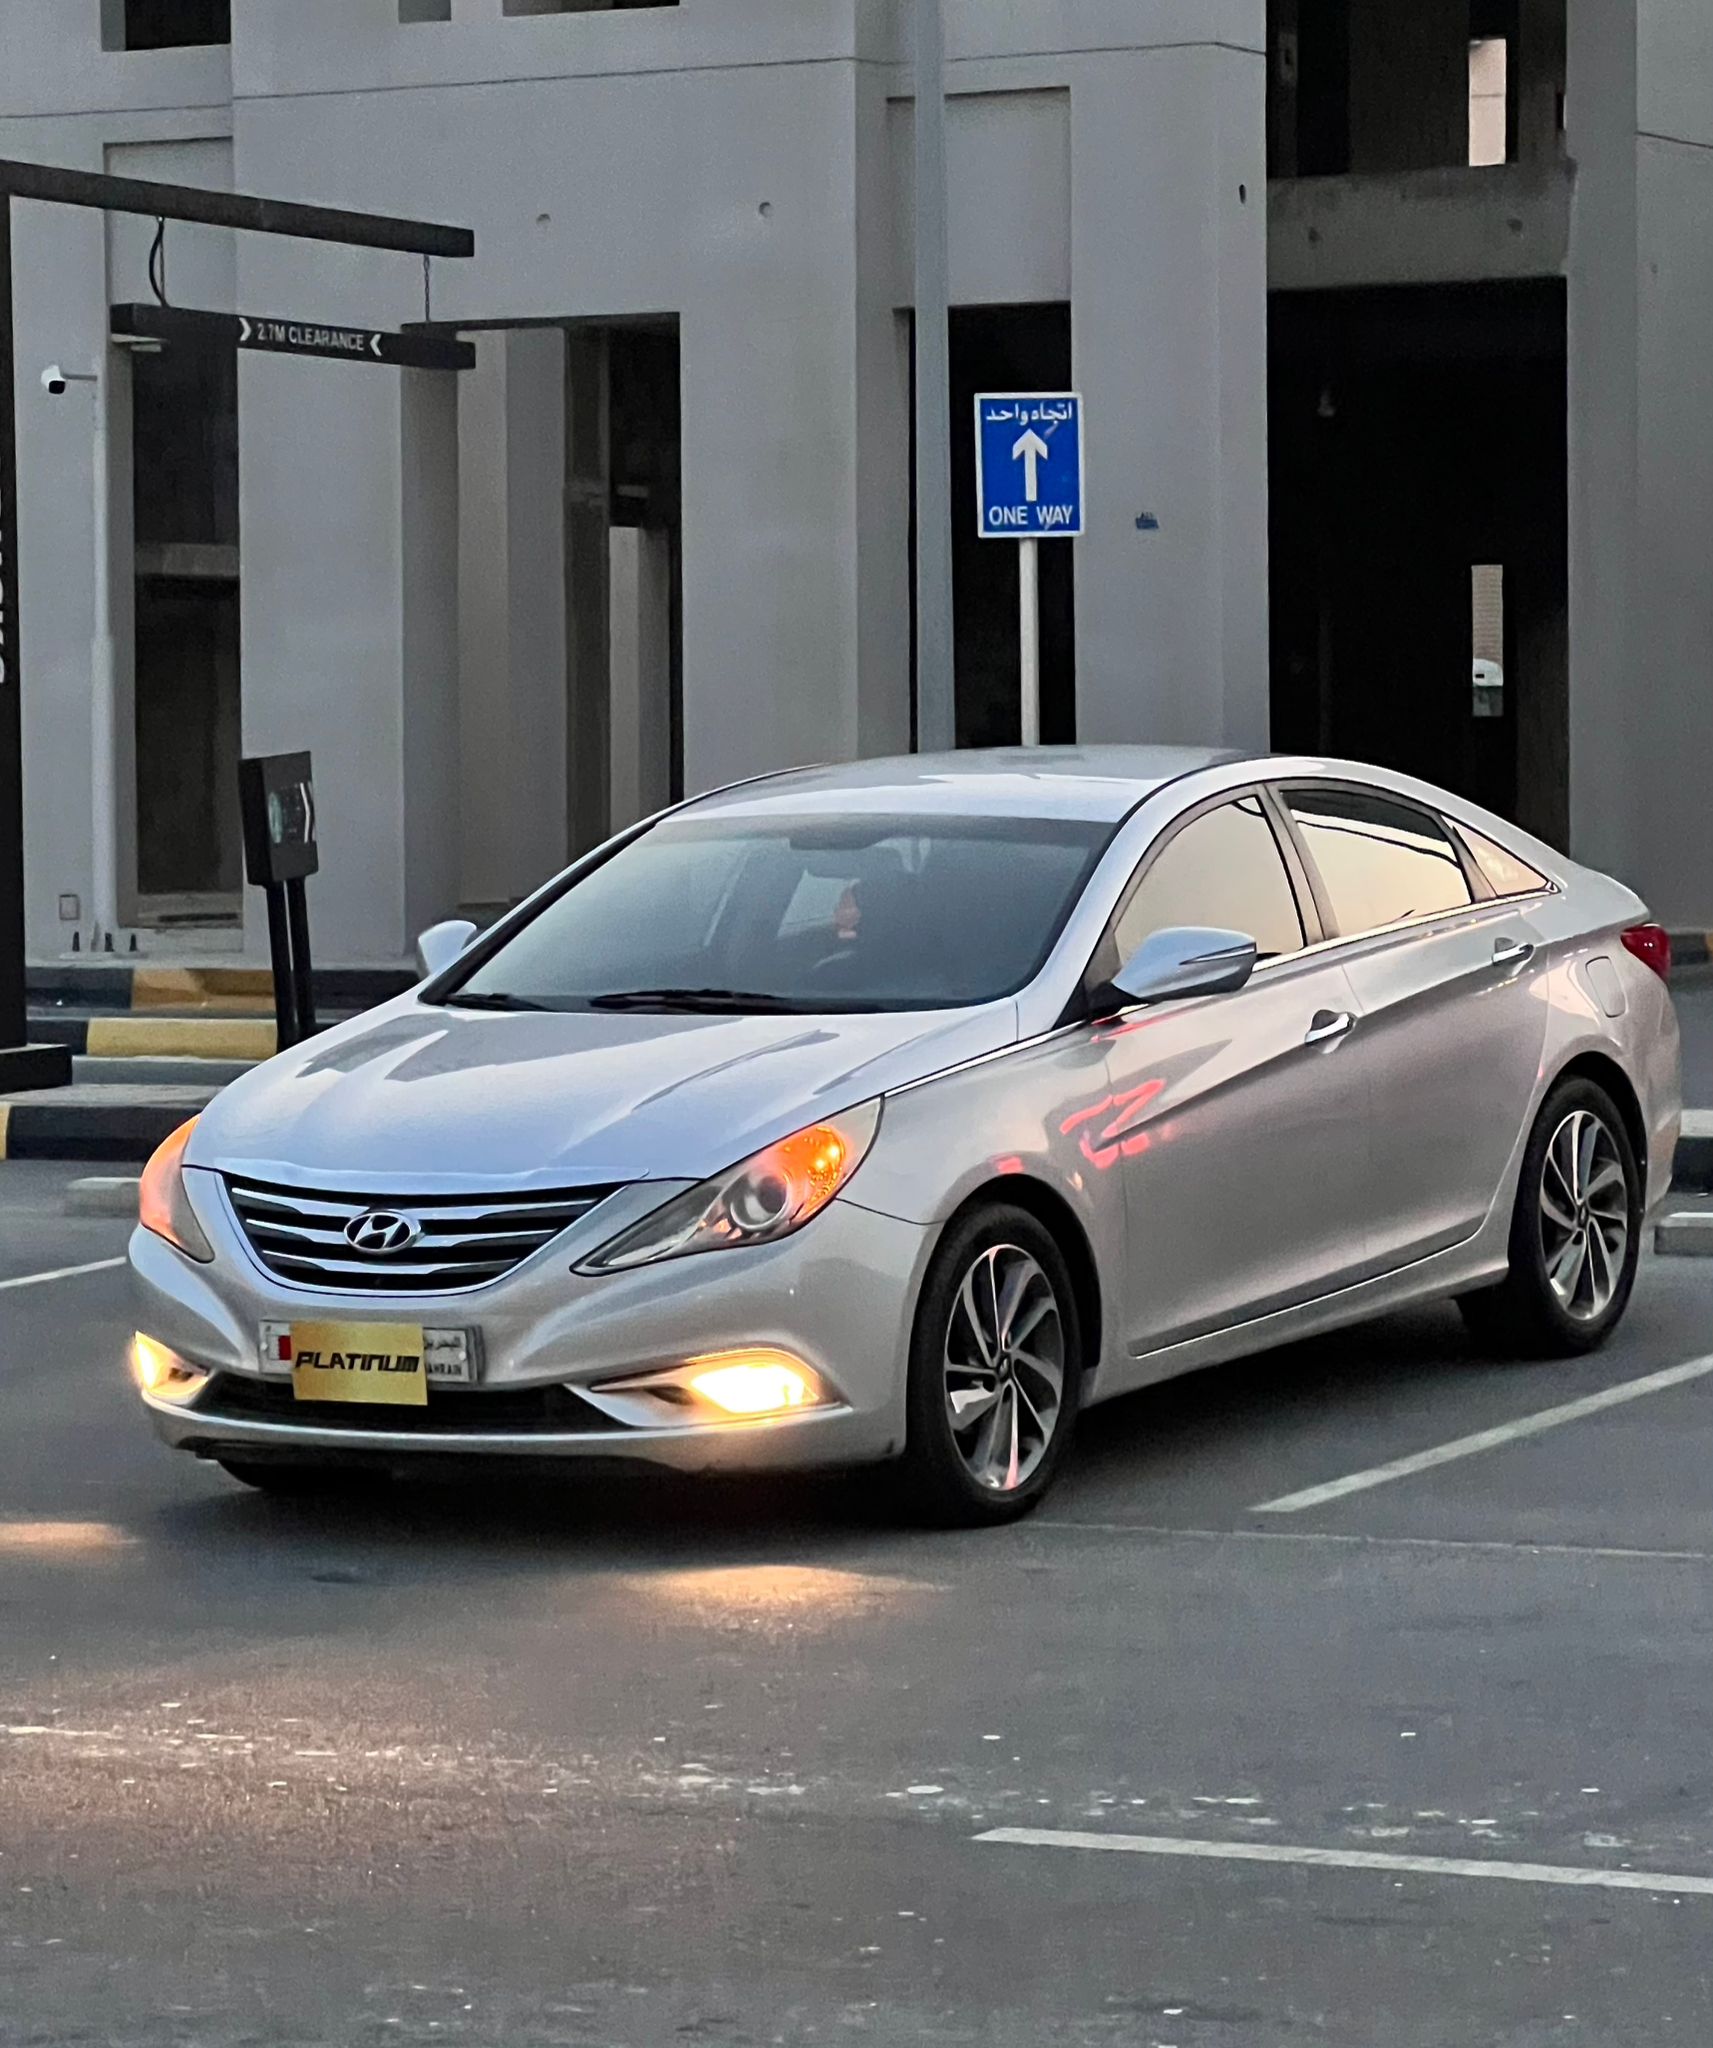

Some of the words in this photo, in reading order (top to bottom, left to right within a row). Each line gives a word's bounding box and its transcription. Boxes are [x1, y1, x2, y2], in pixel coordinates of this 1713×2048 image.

[288, 326, 364, 351] CLEARANCE
[986, 402, 1029, 426] واحد
[1031, 401, 1073, 424] اتجاه
[988, 505, 1028, 525] ONE
[1036, 505, 1073, 525] WAY
[295, 1351, 420, 1373] PLATINUM
